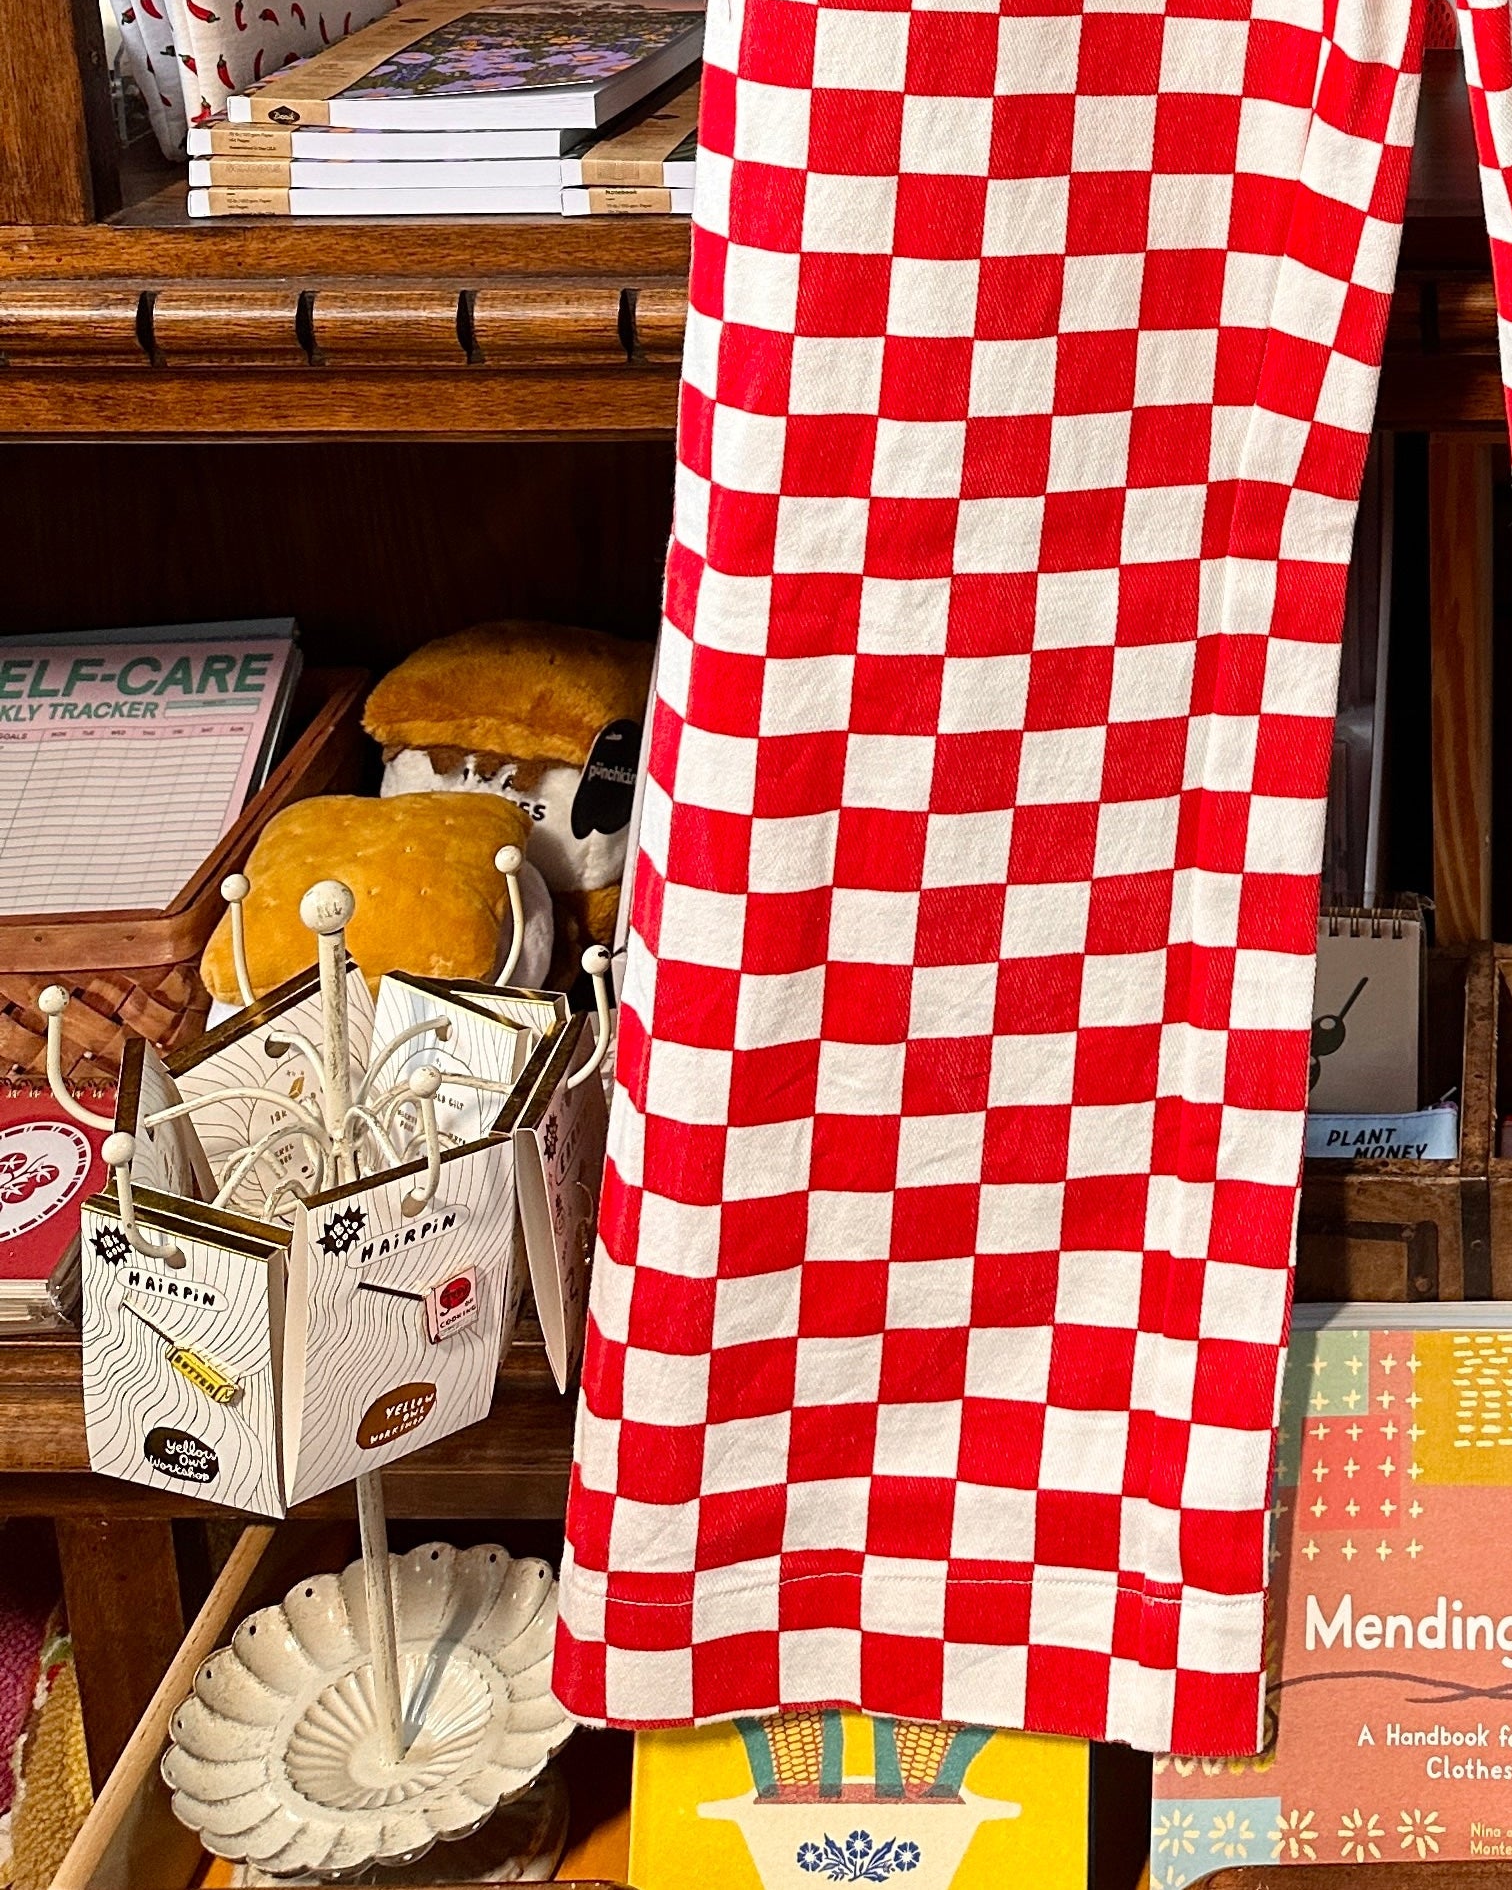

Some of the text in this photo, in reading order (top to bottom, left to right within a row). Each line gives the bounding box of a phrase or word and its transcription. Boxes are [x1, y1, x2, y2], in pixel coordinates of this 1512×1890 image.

[0, 653, 274, 699] ELF-CARE
[48, 701, 160, 720] TRACKER
[1326, 1127, 1397, 1146] PLANT
[1353, 1143, 1428, 1159] MONEY
[173, 1353, 217, 1395] BUTTER
[385, 1392, 435, 1419] YELLOW
[148, 1454, 211, 1482] Workshop
[178, 1451, 209, 1469] Owl
[1356, 1723, 1375, 1747] A
[1386, 1723, 1490, 1747] Handbook
[1426, 1756, 1512, 1781] Clothes
[1470, 1822, 1501, 1838] Nina
